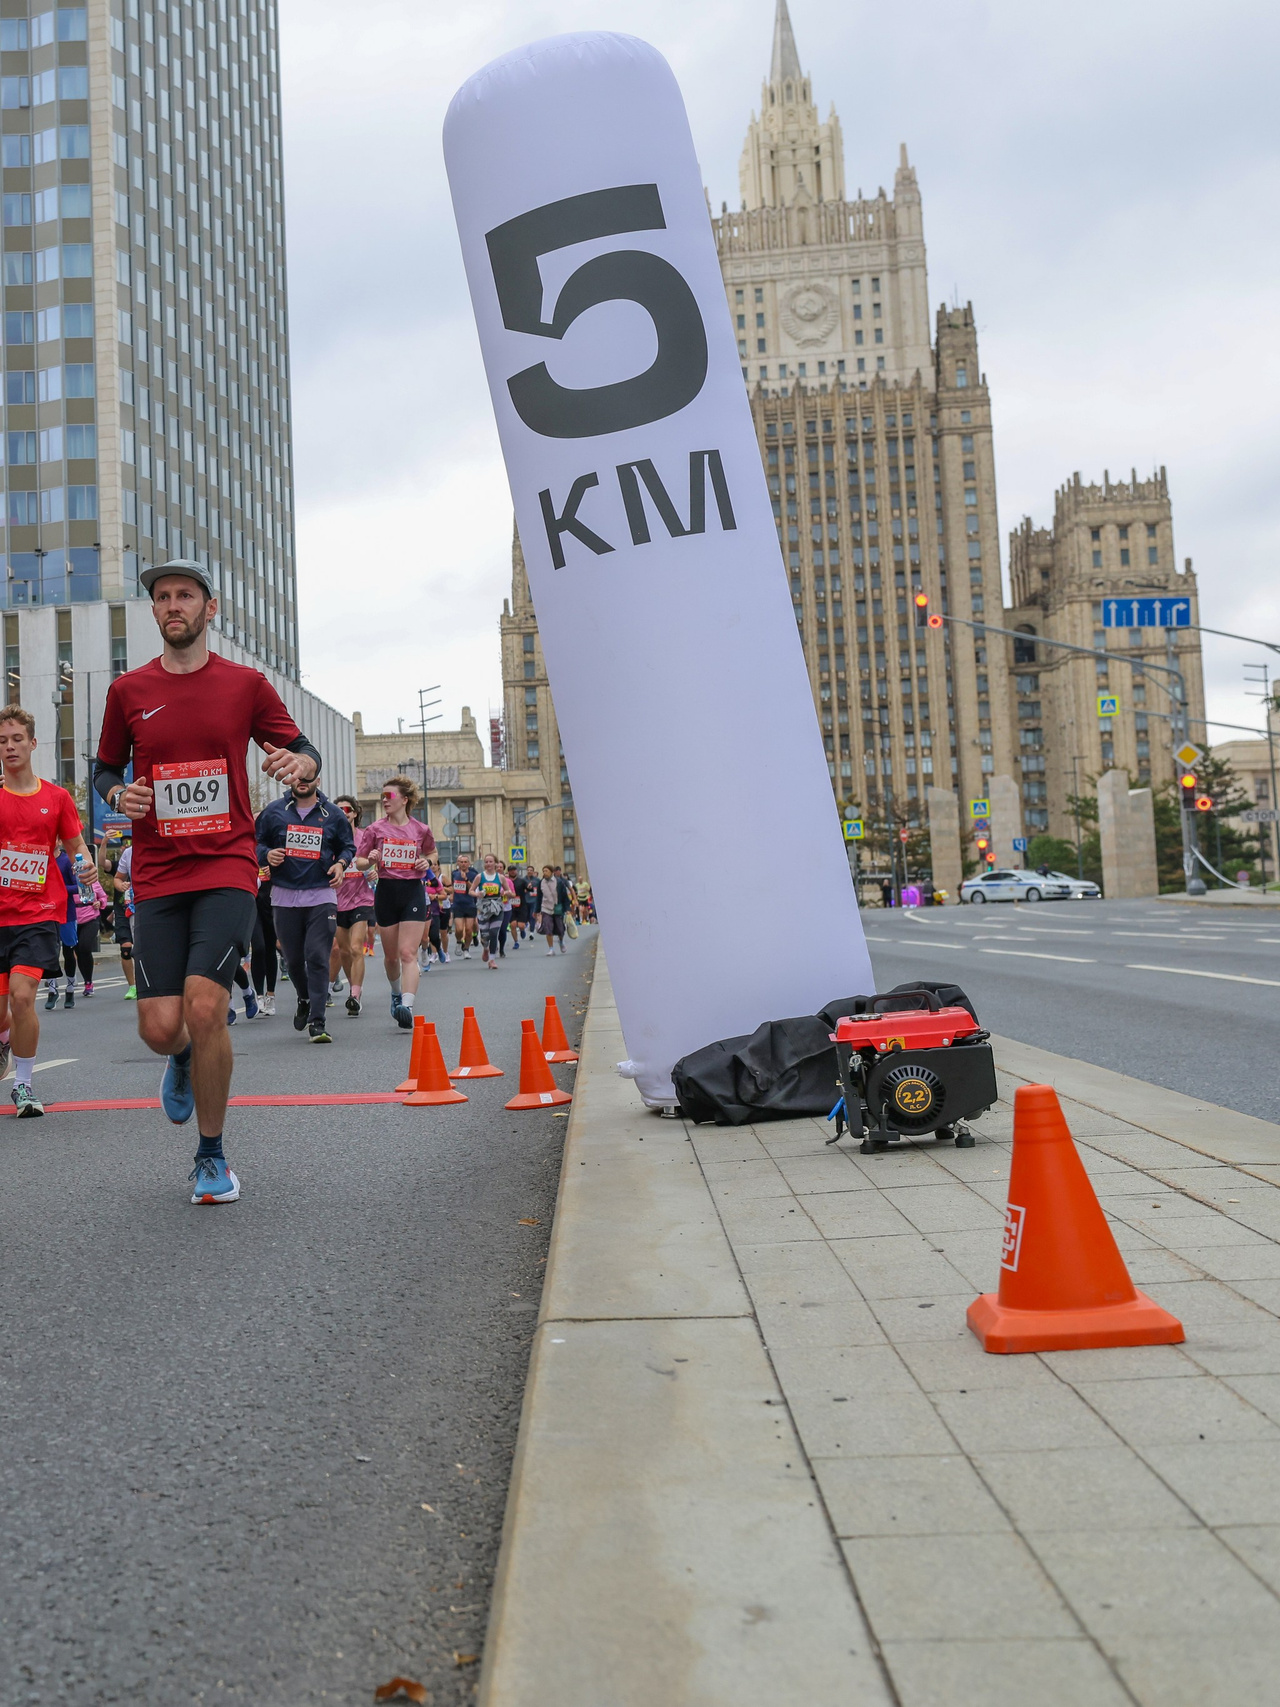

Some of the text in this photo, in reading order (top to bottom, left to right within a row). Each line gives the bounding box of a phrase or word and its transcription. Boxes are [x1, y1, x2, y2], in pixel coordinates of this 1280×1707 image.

[484, 182, 708, 439] 5
[199, 769, 209, 777] 10
[164, 779, 220, 805] 1069
[177, 805, 209, 815] МАКСИМ
[287, 833, 320, 846] 23253
[383, 847, 415, 860] 26318
[0, 856, 45, 876] 26476
[902, 1089, 926, 1104] 2,2
